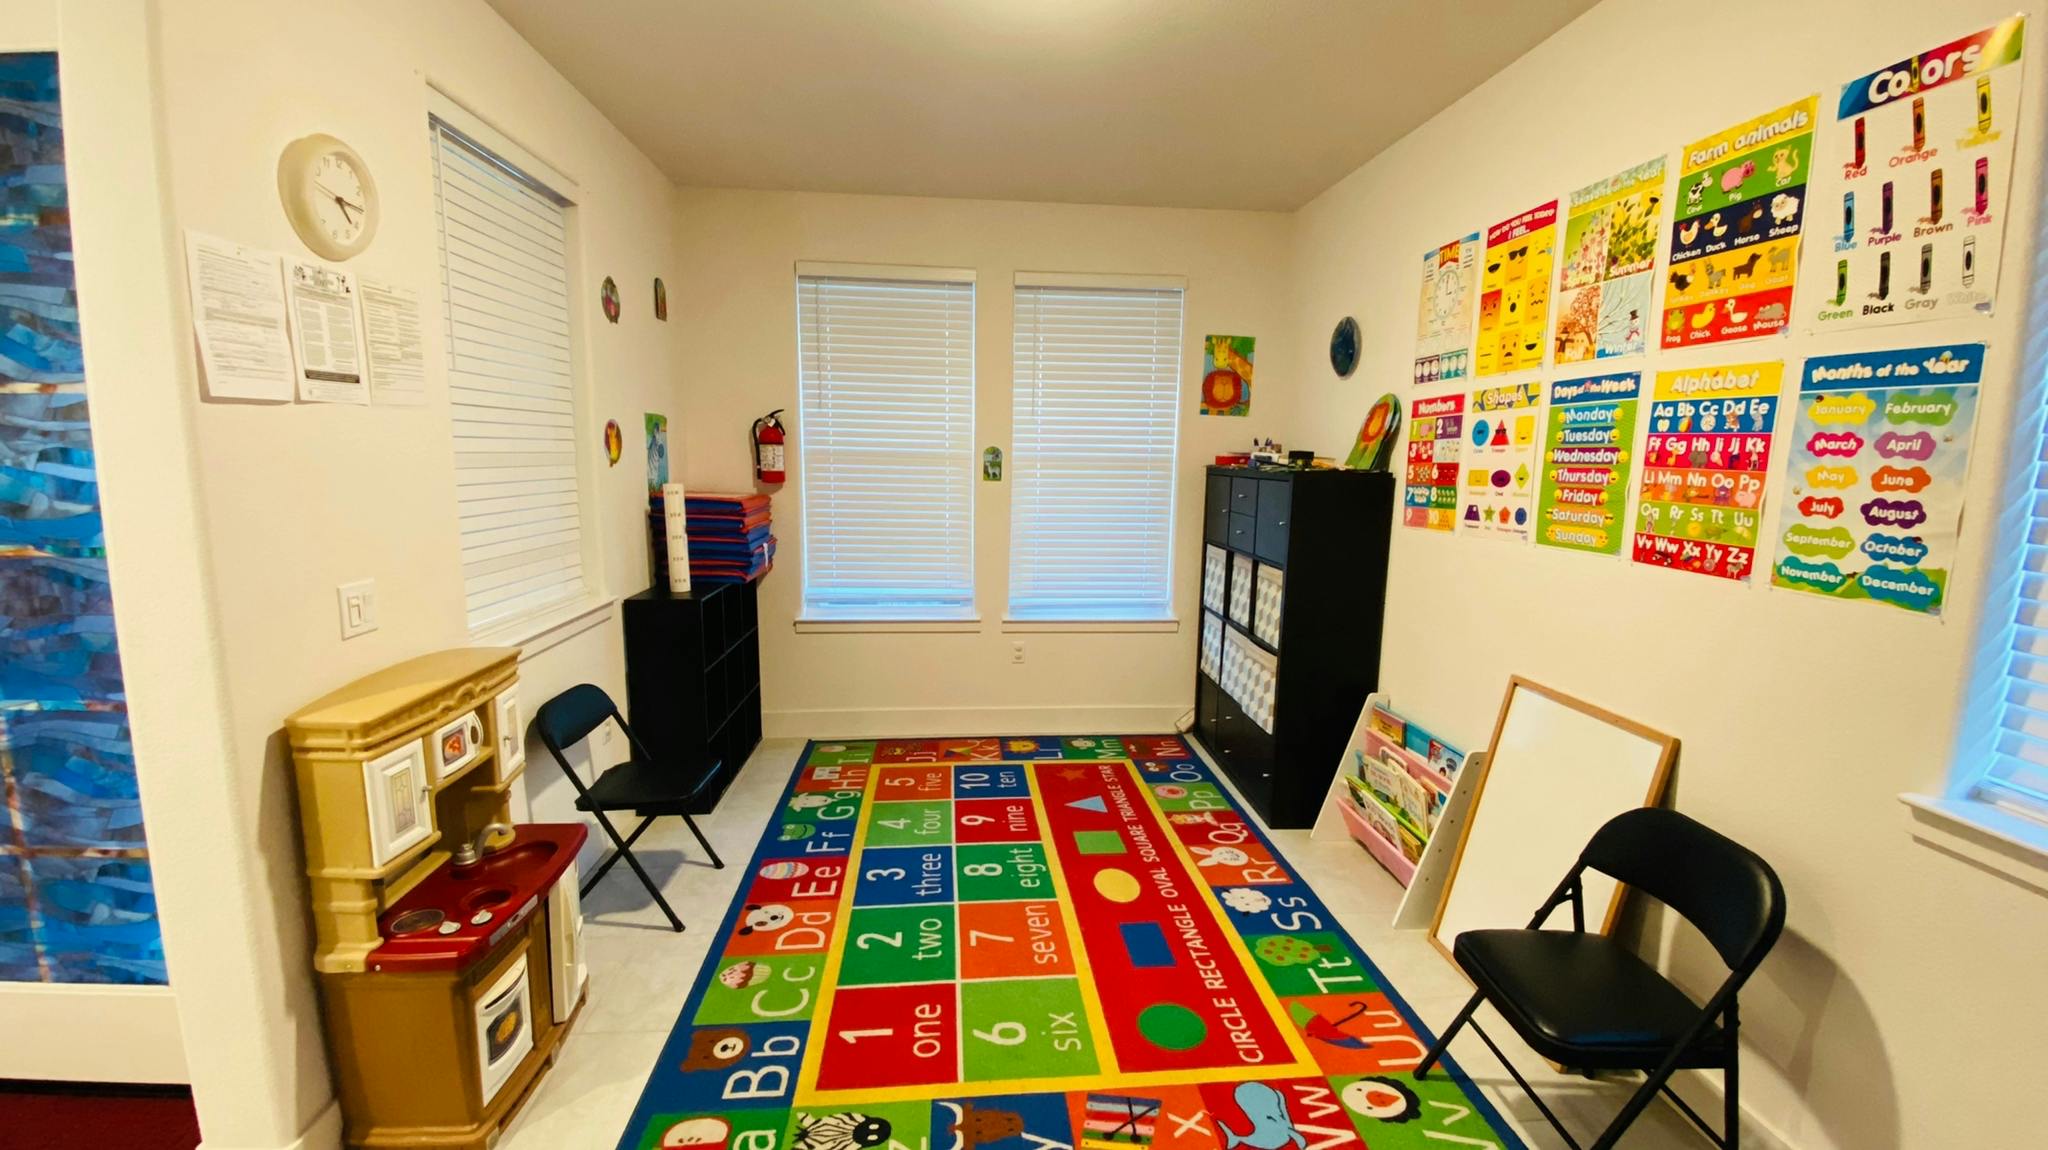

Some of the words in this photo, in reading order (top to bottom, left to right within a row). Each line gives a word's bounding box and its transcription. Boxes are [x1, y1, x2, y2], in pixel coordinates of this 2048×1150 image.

[1688, 141, 1729, 168] Farm
[1734, 110, 1809, 150] animals
[1844, 167, 1868, 180] Red
[1889, 148, 1938, 168] Orange
[1868, 232, 1902, 247] Purple
[1913, 223, 1954, 238] Brown
[1967, 215, 1993, 227] Pink
[1672, 248, 1701, 262] Chicken
[1706, 241, 1727, 253] Duck
[1734, 233, 1760, 246] Horse
[1768, 224, 1799, 237] Sheep
[1610, 259, 1652, 277] Summer
[1818, 308, 1853, 321] Green
[1862, 303, 1895, 316] Black
[1905, 298, 1939, 310] Gray
[1753, 319, 1785, 331] Mouse
[1812, 362, 1873, 384] Months
[1876, 364, 1892, 378] of
[1895, 362, 1920, 376] the
[1922, 356, 1970, 374] Year
[1554, 385, 1578, 400] Days
[1601, 377, 1636, 394] Week
[1671, 370, 1760, 395] Alphabet
[1418, 398, 1456, 414] Numbers
[1566, 407, 1613, 424] Monday
[1654, 402, 1674, 417] Aa
[1677, 402, 1695, 417] Bb
[1699, 401, 1719, 416] Cc
[1723, 400, 1746, 415] Dd
[1749, 399, 1770, 415] Ee
[1816, 403, 1866, 416] January
[1884, 402, 1952, 416] February
[1564, 428, 1611, 443] Tuesday
[1648, 437, 1662, 451] Ff
[1665, 437, 1687, 454] Gg
[1692, 437, 1710, 452] Hh
[1745, 437, 1765, 453] Kk
[1815, 439, 1857, 451] March
[1886, 439, 1922, 453] April
[1553, 448, 1619, 465] Wednesday
[1557, 468, 1609, 486] Thursday
[1658, 471, 1682, 485] Mm
[1687, 472, 1707, 487] Nn
[1711, 473, 1734, 489] Oo
[1739, 474, 1760, 491] Pp
[1817, 469, 1845, 483] May
[1881, 473, 1914, 486] June
[1562, 489, 1597, 506] Friday
[1552, 508, 1605, 527] Saturday
[1640, 503, 1660, 520] Qq
[1669, 505, 1685, 520] Rr
[1690, 507, 1704, 522] Ss
[1710, 509, 1725, 524] Tt
[1734, 512, 1754, 527] Uu
[1809, 501, 1835, 514] July
[1869, 505, 1920, 521] August
[1555, 528, 1597, 547] Sunday
[1786, 532, 1852, 549] September
[1864, 541, 1922, 557] October
[1637, 534, 1653, 549] Vv
[1654, 537, 1679, 553] Ww
[1683, 541, 1701, 557] Xx
[1705, 544, 1723, 562] Yy
[1727, 547, 1749, 565] Zz
[1781, 565, 1843, 584] November
[1862, 575, 1934, 597] December
[1095, 738, 1127, 759] Mm
[1153, 740, 1186, 757] Nn
[829, 769, 868, 790] Hh
[885, 776, 916, 787] 5
[918, 772, 942, 792] five
[960, 772, 991, 789] 10
[997, 771, 1017, 788] ten
[1098, 765, 1119, 783] STAR
[1170, 763, 1202, 782] Oo
[817, 790, 861, 821] Gg
[1107, 784, 1138, 822] TRIANGLE
[1189, 790, 1225, 809] Pp
[877, 818, 912, 830] 4
[914, 808, 941, 836] four
[960, 815, 996, 826] 9
[1002, 805, 1028, 832] nine
[805, 831, 850, 853] Ff
[1127, 823, 1160, 862] SQUARE
[1208, 822, 1248, 844] Qq
[866, 868, 906, 881] 3
[912, 853, 942, 896] three
[963, 863, 1003, 877] 8
[1006, 848, 1047, 888] eight
[1242, 857, 1287, 883] Rr
[791, 866, 841, 897] Ee
[1149, 867, 1178, 898] OVAL
[1271, 896, 1322, 931] Ss
[775, 911, 832, 950] Dd
[856, 932, 903, 950] 2
[912, 918, 942, 960] two
[969, 930, 1015, 947] 7
[1025, 904, 1058, 965] seven
[1167, 904, 1228, 990] RECTANGLE
[1307, 956, 1363, 993] Tt
[751, 966, 815, 1017] Cc
[838, 1028, 893, 1044] 1
[913, 1003, 941, 1058] one
[972, 1021, 1027, 1046] 6
[1041, 1011, 1082, 1051] six
[1213, 997, 1264, 1063] CIRCLE
[1360, 1010, 1429, 1067] Uu
[722, 1036, 800, 1100] Bb
